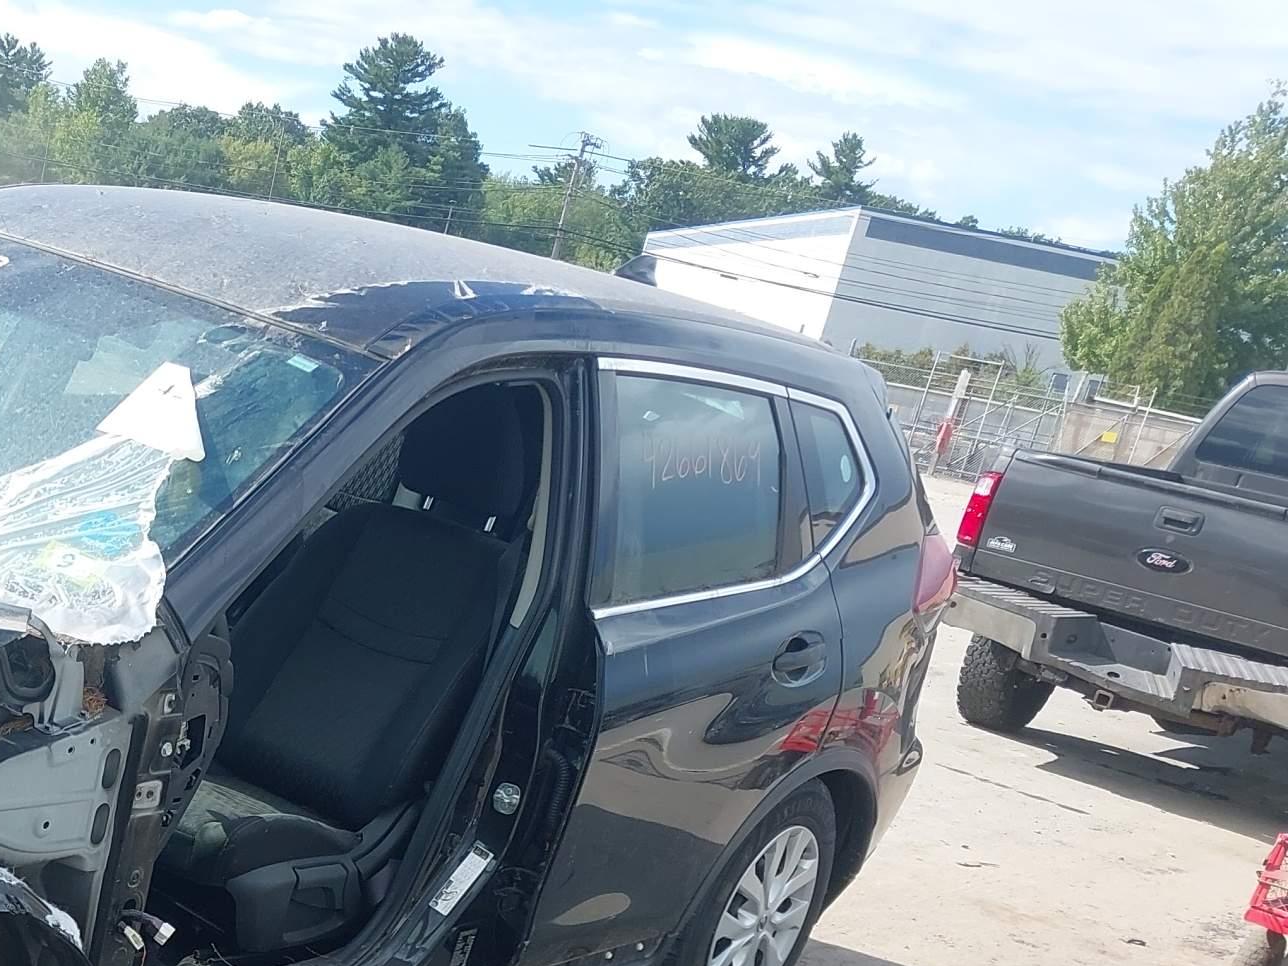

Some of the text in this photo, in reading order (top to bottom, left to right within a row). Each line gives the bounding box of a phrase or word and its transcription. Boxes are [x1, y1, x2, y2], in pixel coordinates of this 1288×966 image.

[643, 434, 761, 489] 42661869
[1146, 552, 1178, 568] Ford
[1027, 569, 1273, 643] SUPER DUTY
